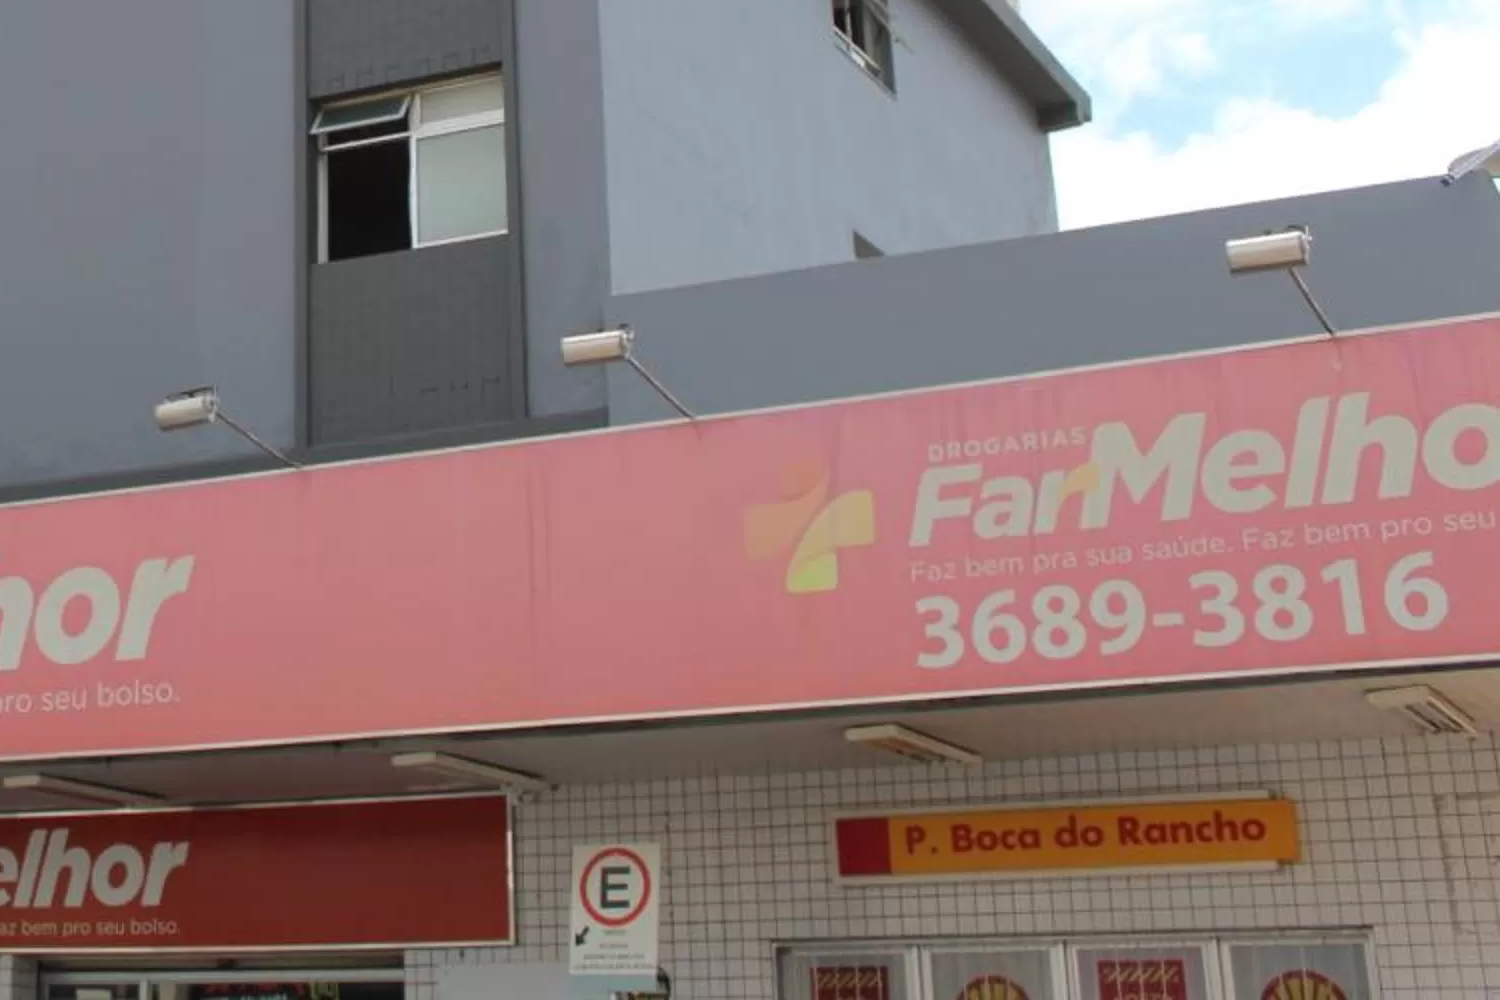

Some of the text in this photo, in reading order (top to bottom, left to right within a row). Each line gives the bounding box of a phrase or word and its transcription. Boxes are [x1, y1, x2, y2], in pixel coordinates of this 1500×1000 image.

[928, 427, 1086, 462] DROGARIAS
[909, 509, 1497, 584] Faz bem pra sua saúde. Faz bem pro seu
[915, 550, 1448, 670] 3689-3816
[40, 687, 87, 712] seu
[96, 680, 180, 707] bolso.
[904, 809, 1267, 855] P. Boca do Rancho
[601, 865, 631, 909] E
[21, 919, 57, 936] bem
[62, 921, 91, 937] pro
[95, 921, 125, 936] seu
[129, 917, 181, 936] bolso.
